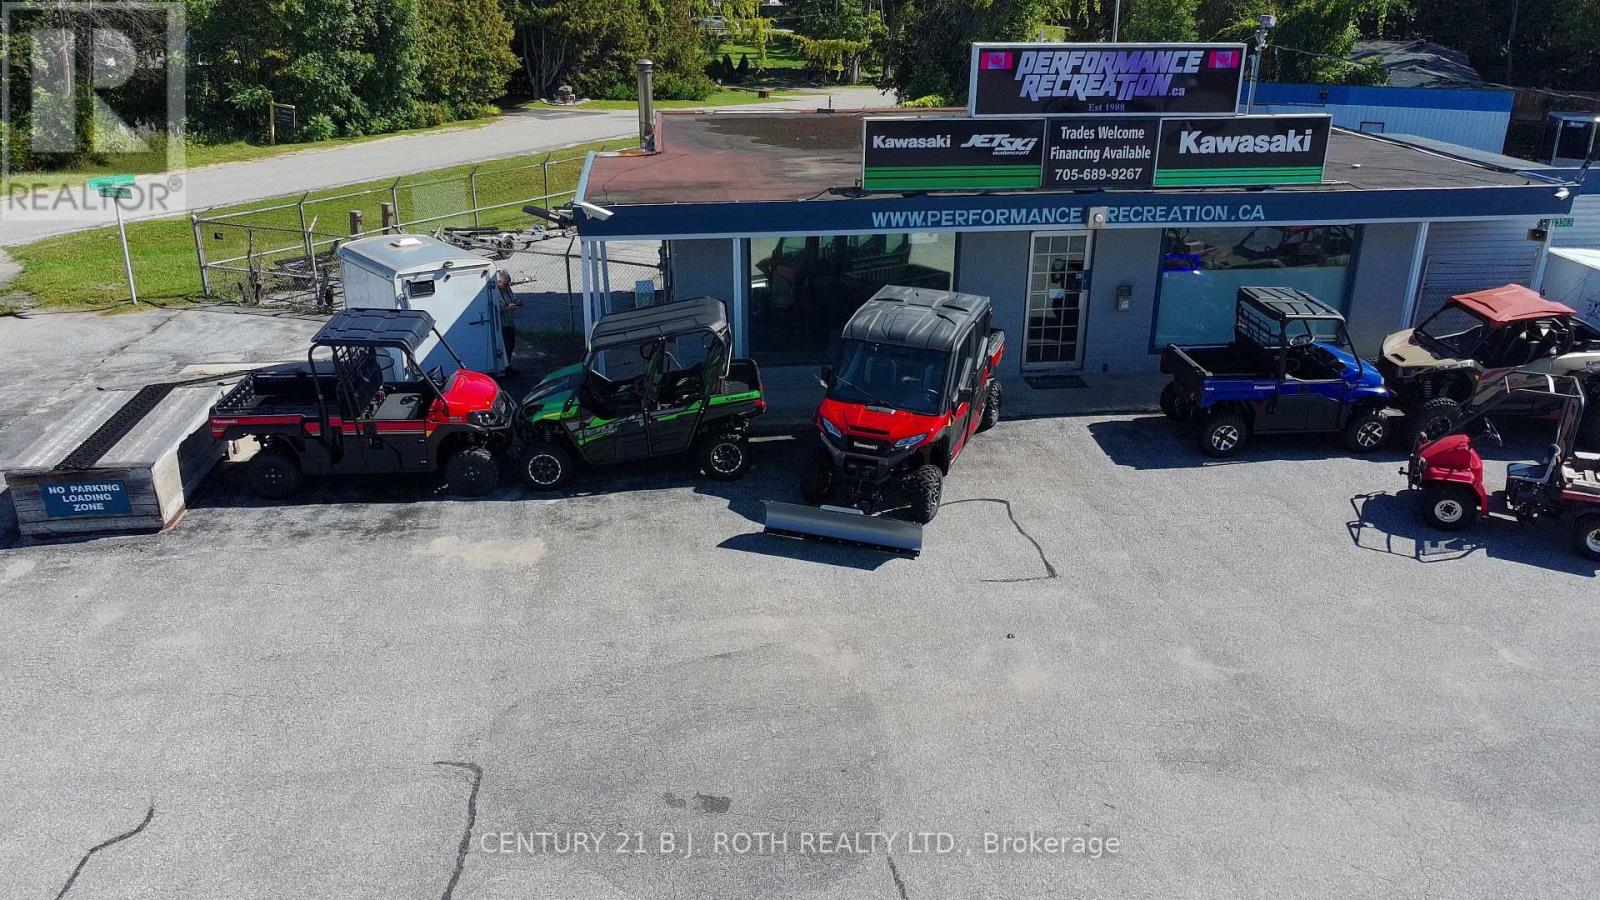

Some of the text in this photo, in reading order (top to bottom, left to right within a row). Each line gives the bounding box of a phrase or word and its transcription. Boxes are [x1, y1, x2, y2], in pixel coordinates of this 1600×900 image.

[1014, 50, 1205, 80] PERFORMANCE
[1088, 103, 1126, 112] Est 1988
[1060, 125, 1145, 140] Trades Welcome
[872, 134, 951, 149] Kawasaki
[1178, 129, 1313, 154] Kawasaki
[1050, 145, 1151, 163] Financing Available
[1054, 168, 1143, 181] 705-689-9267
[871, 206, 1083, 228] WWW.PERFORMANCE
[48, 484, 120, 494] NO PARKING
[62, 493, 112, 503] LOADING
[73, 502, 104, 512] ZONE
